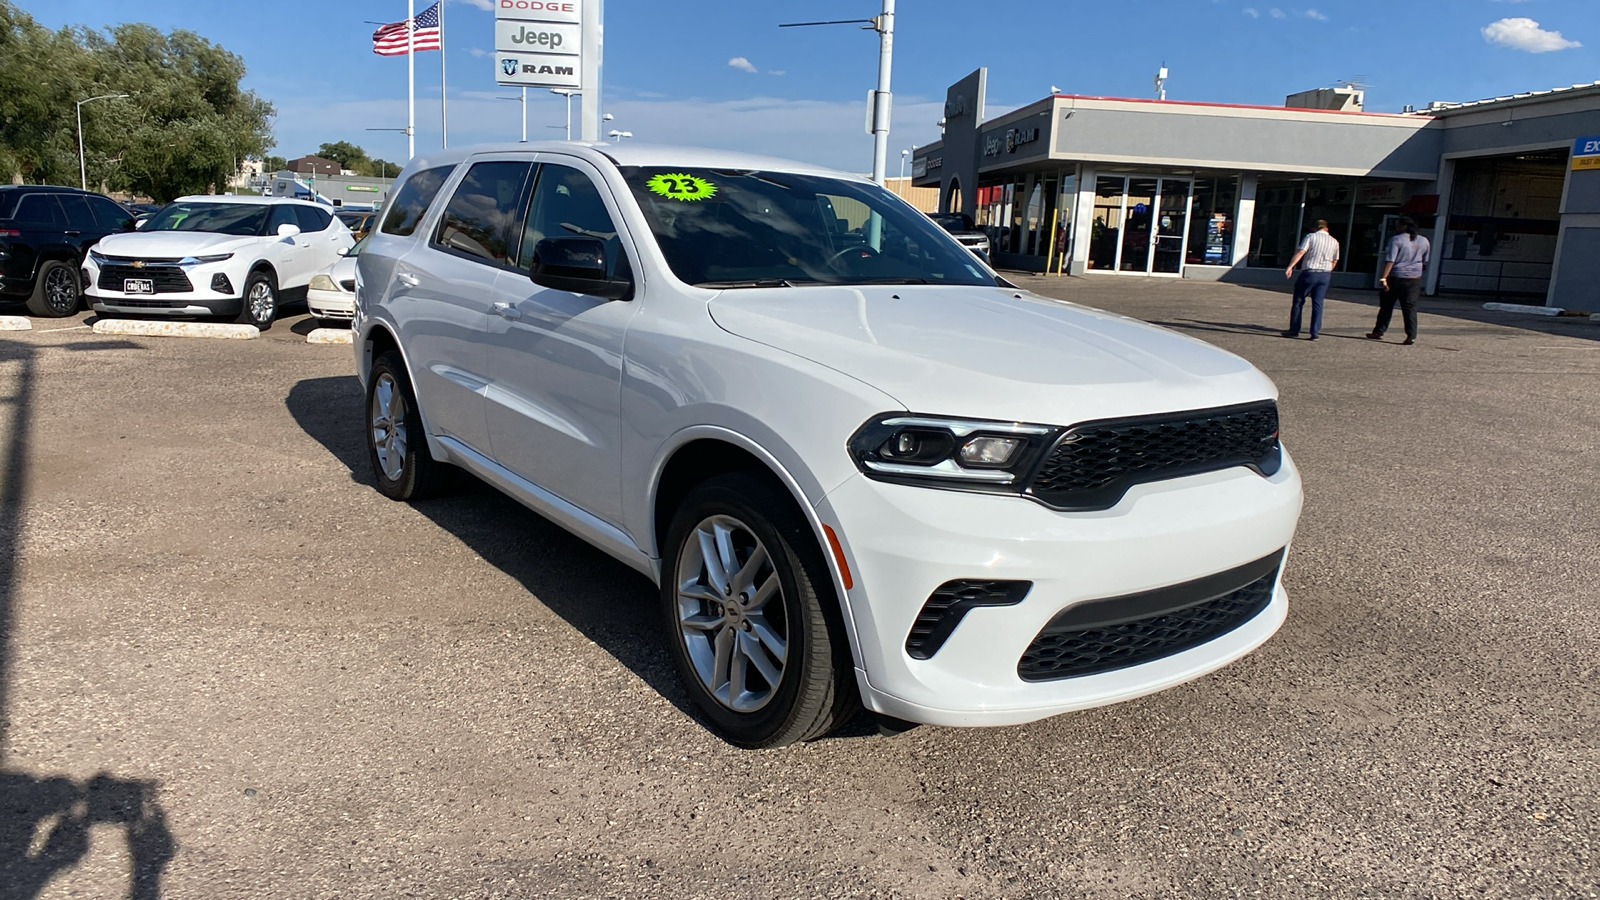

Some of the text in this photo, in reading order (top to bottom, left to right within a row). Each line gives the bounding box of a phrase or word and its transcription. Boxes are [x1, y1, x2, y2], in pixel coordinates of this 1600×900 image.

[501, 0, 574, 12] DODGE
[511, 26, 562, 49] Jeep
[522, 64, 573, 76] RAM
[1015, 128, 1035, 145] RAM
[984, 136, 999, 157] Jeep
[927, 157, 942, 169] DODGE
[662, 178, 699, 193] 23
